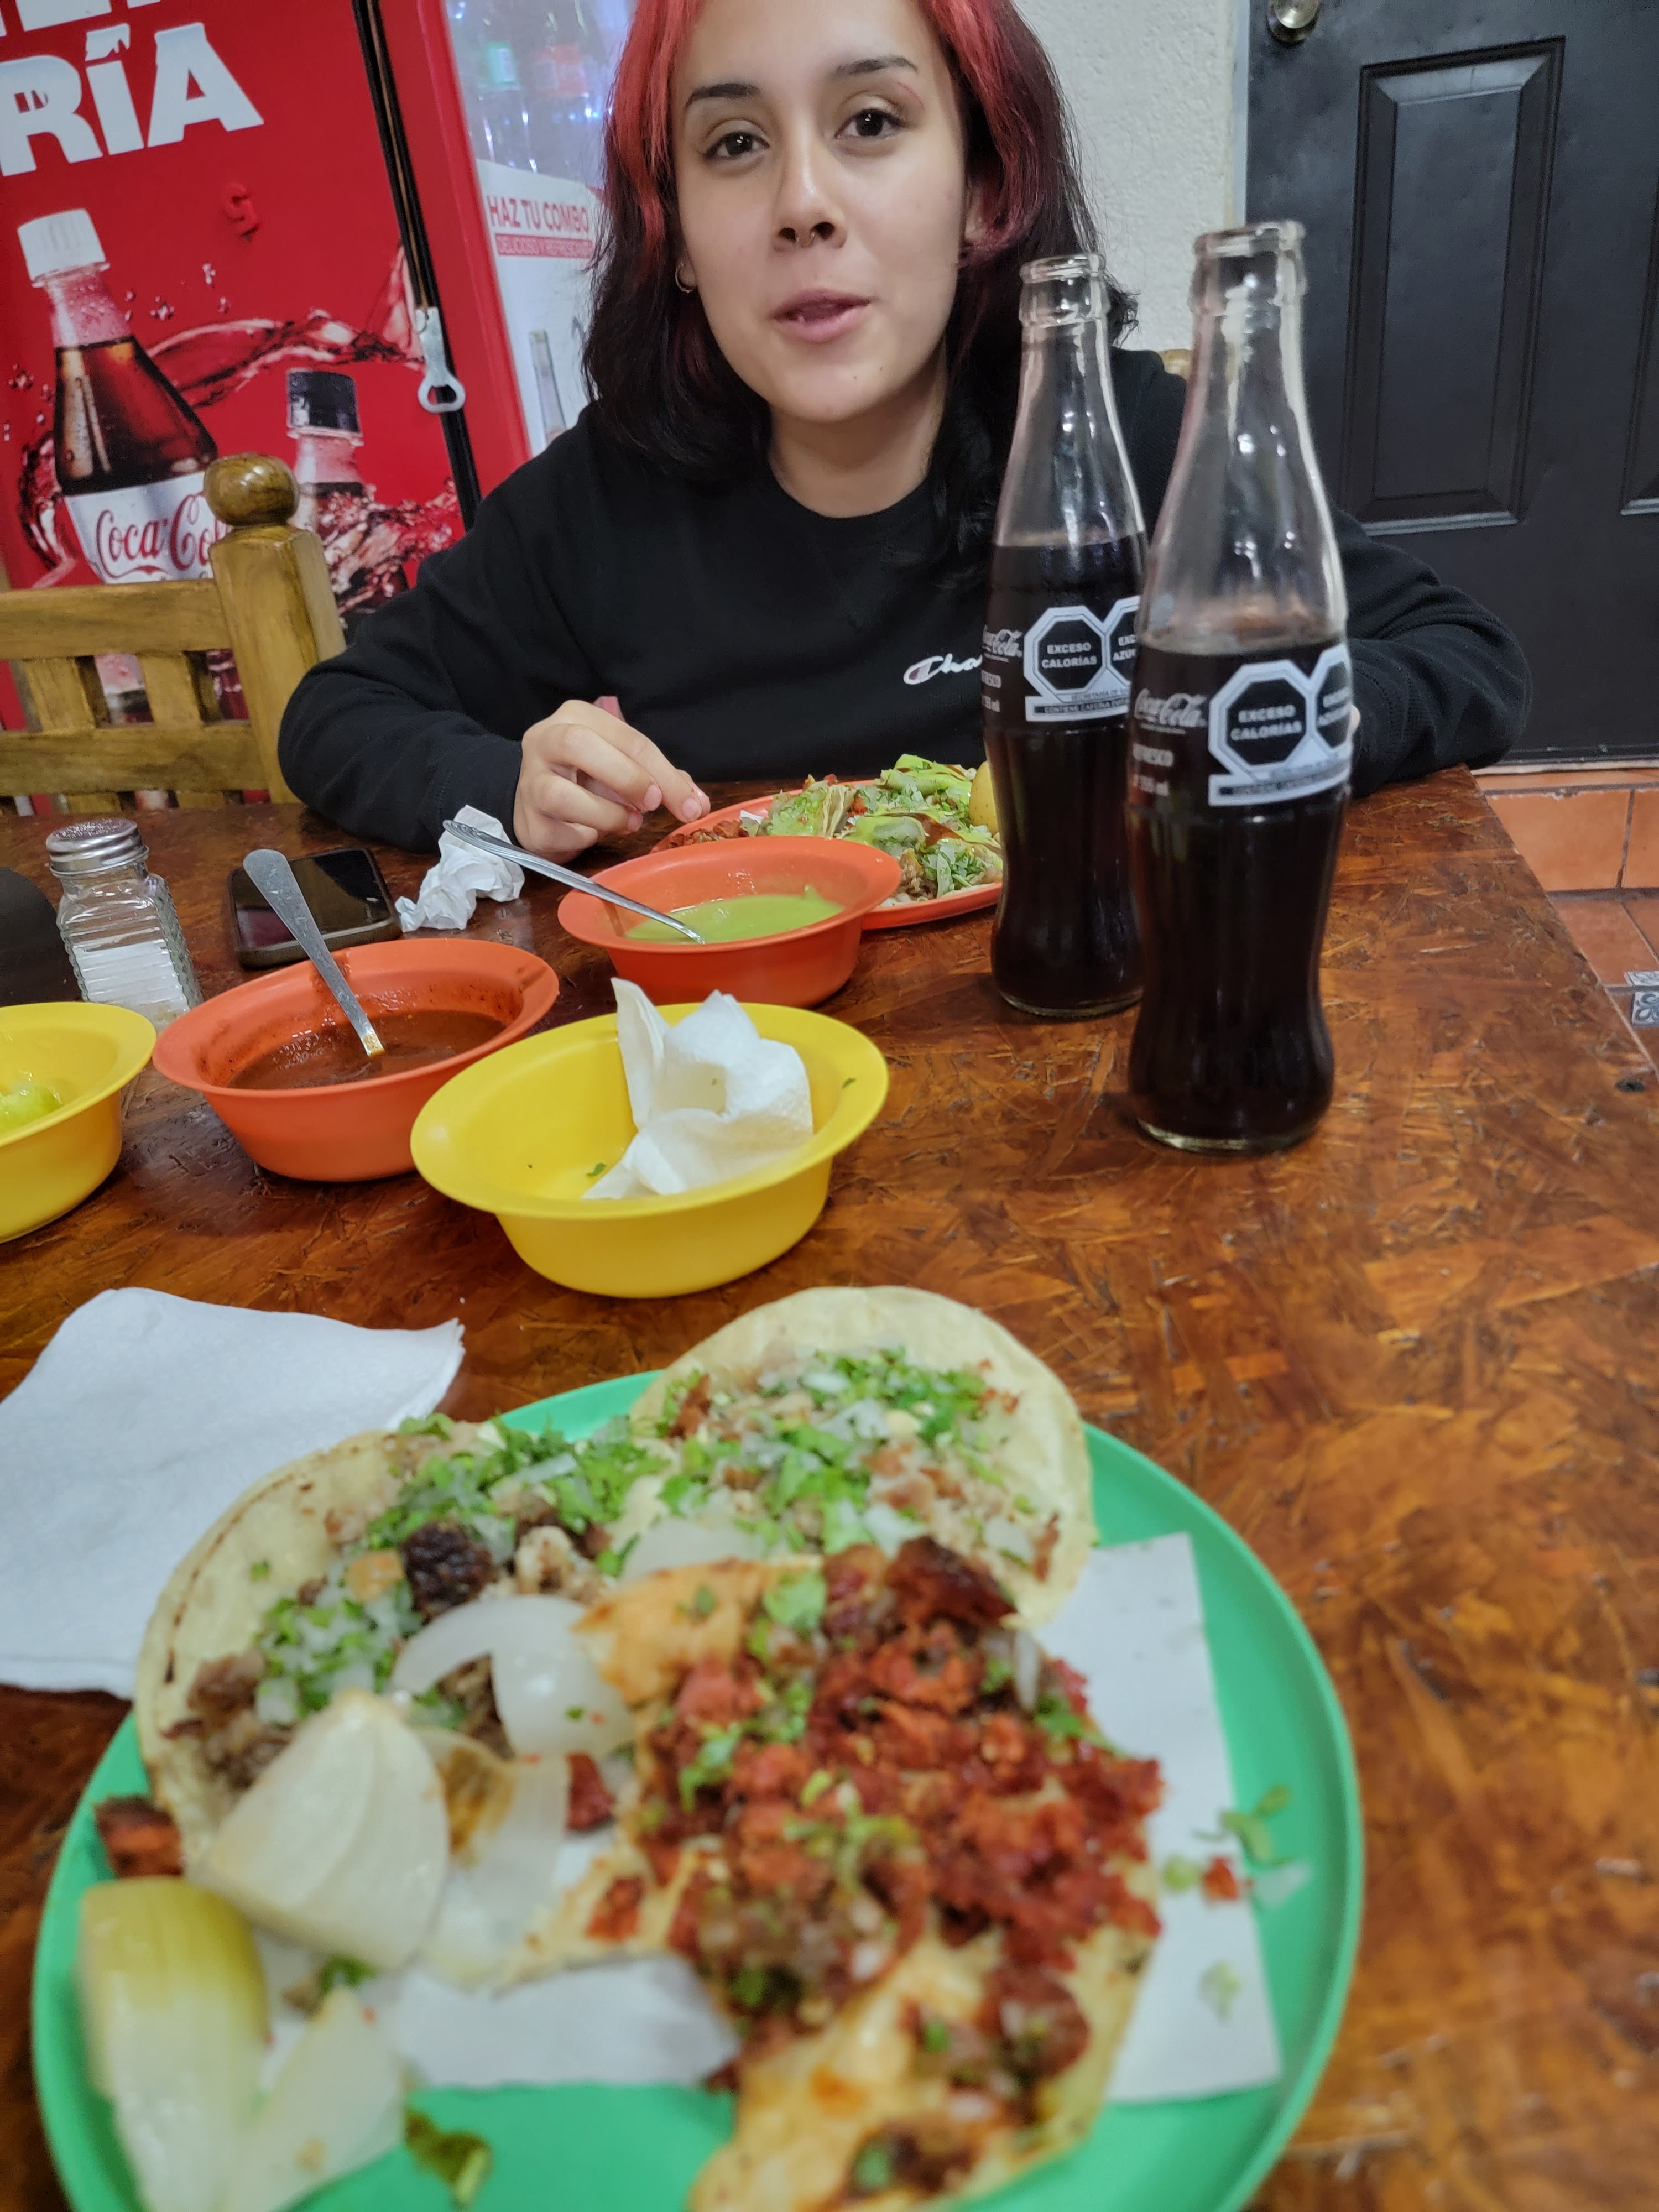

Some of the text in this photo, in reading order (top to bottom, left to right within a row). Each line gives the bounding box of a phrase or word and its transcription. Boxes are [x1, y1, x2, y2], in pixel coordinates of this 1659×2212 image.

[486, 196, 589, 233] HAZ TU COMBO
[1047, 642, 1091, 654] EXCESO
[903, 653, 983, 685] Cha
[1041, 656, 1097, 669] CALORÍAS
[1239, 704, 1295, 723] EXCESO
[1230, 720, 1302, 742] CALORÍAS
